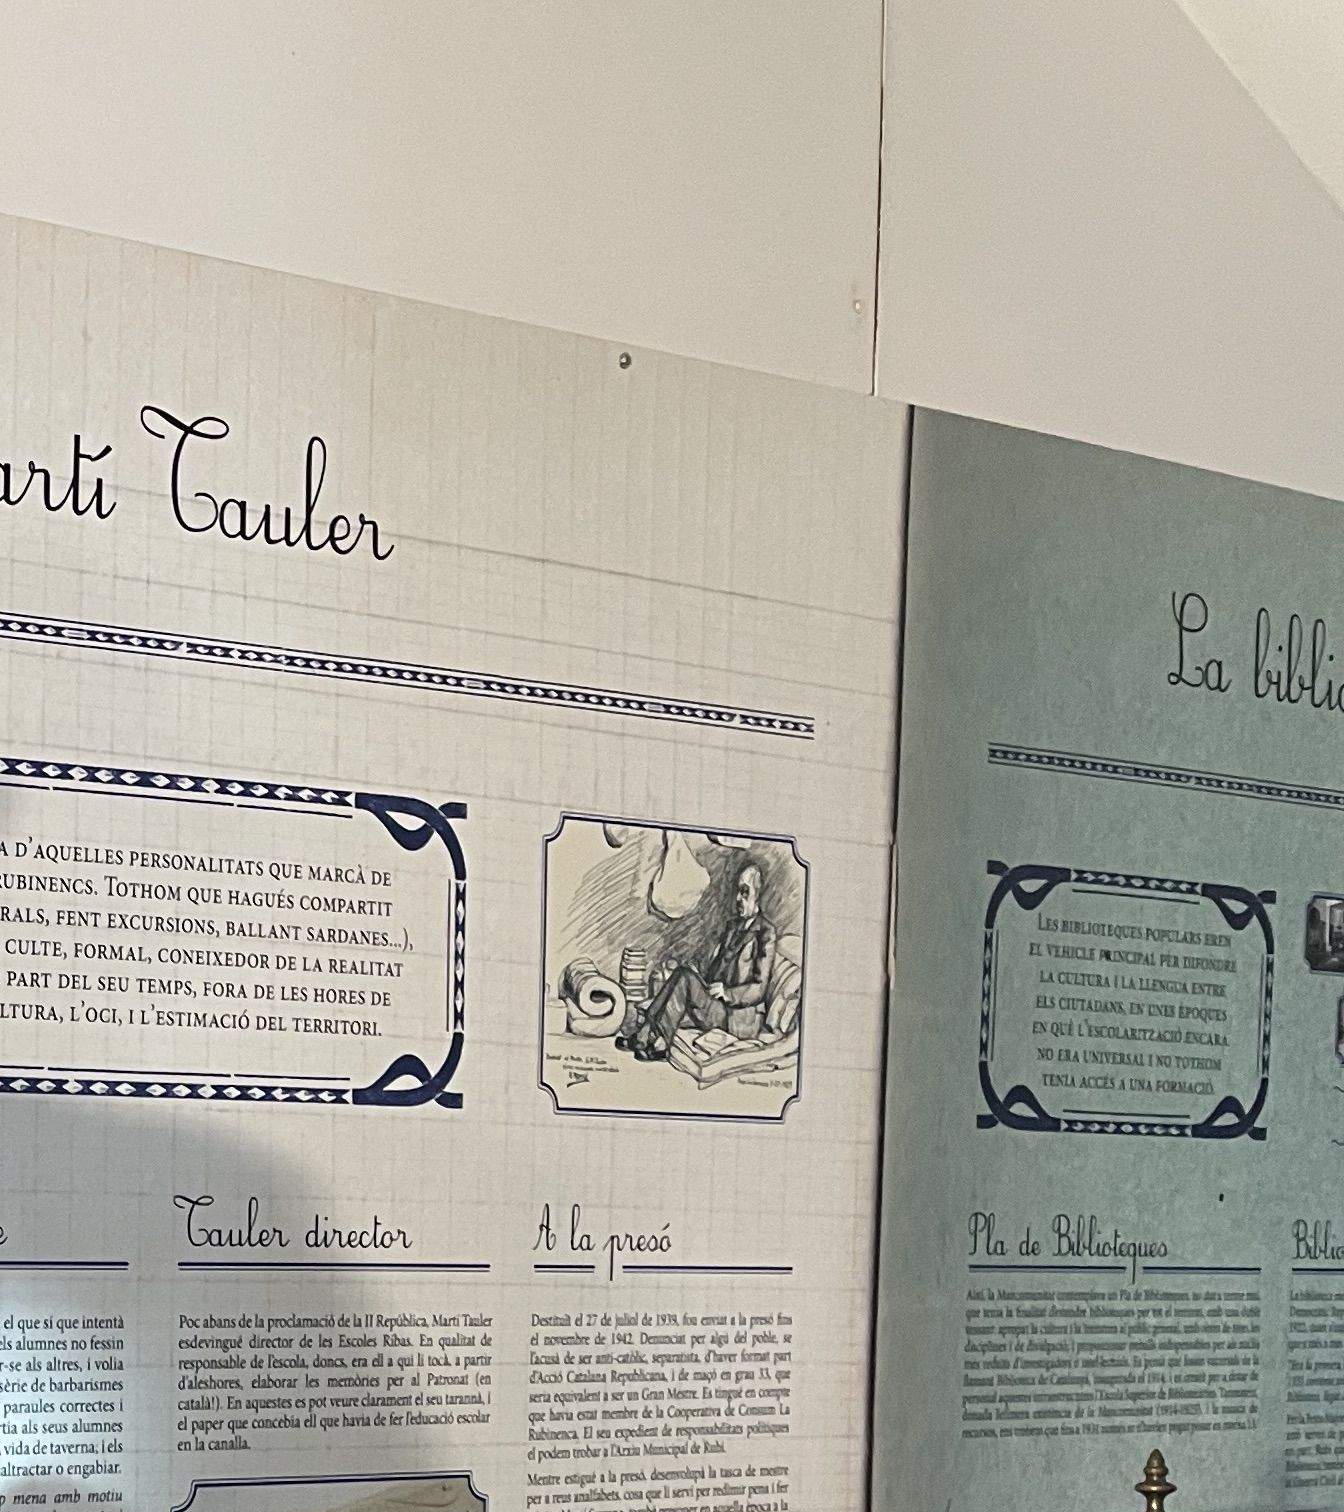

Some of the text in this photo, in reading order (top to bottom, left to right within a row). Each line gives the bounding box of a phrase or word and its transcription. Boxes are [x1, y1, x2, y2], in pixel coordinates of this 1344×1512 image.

[140, 405, 394, 560] Tauler
[1167, 591, 1233, 693] La
[173, 1195, 413, 1248] Tauler director
[533, 1203, 672, 1281] A la presó
[968, 1212, 1168, 1285] Pla de Biblioteques
